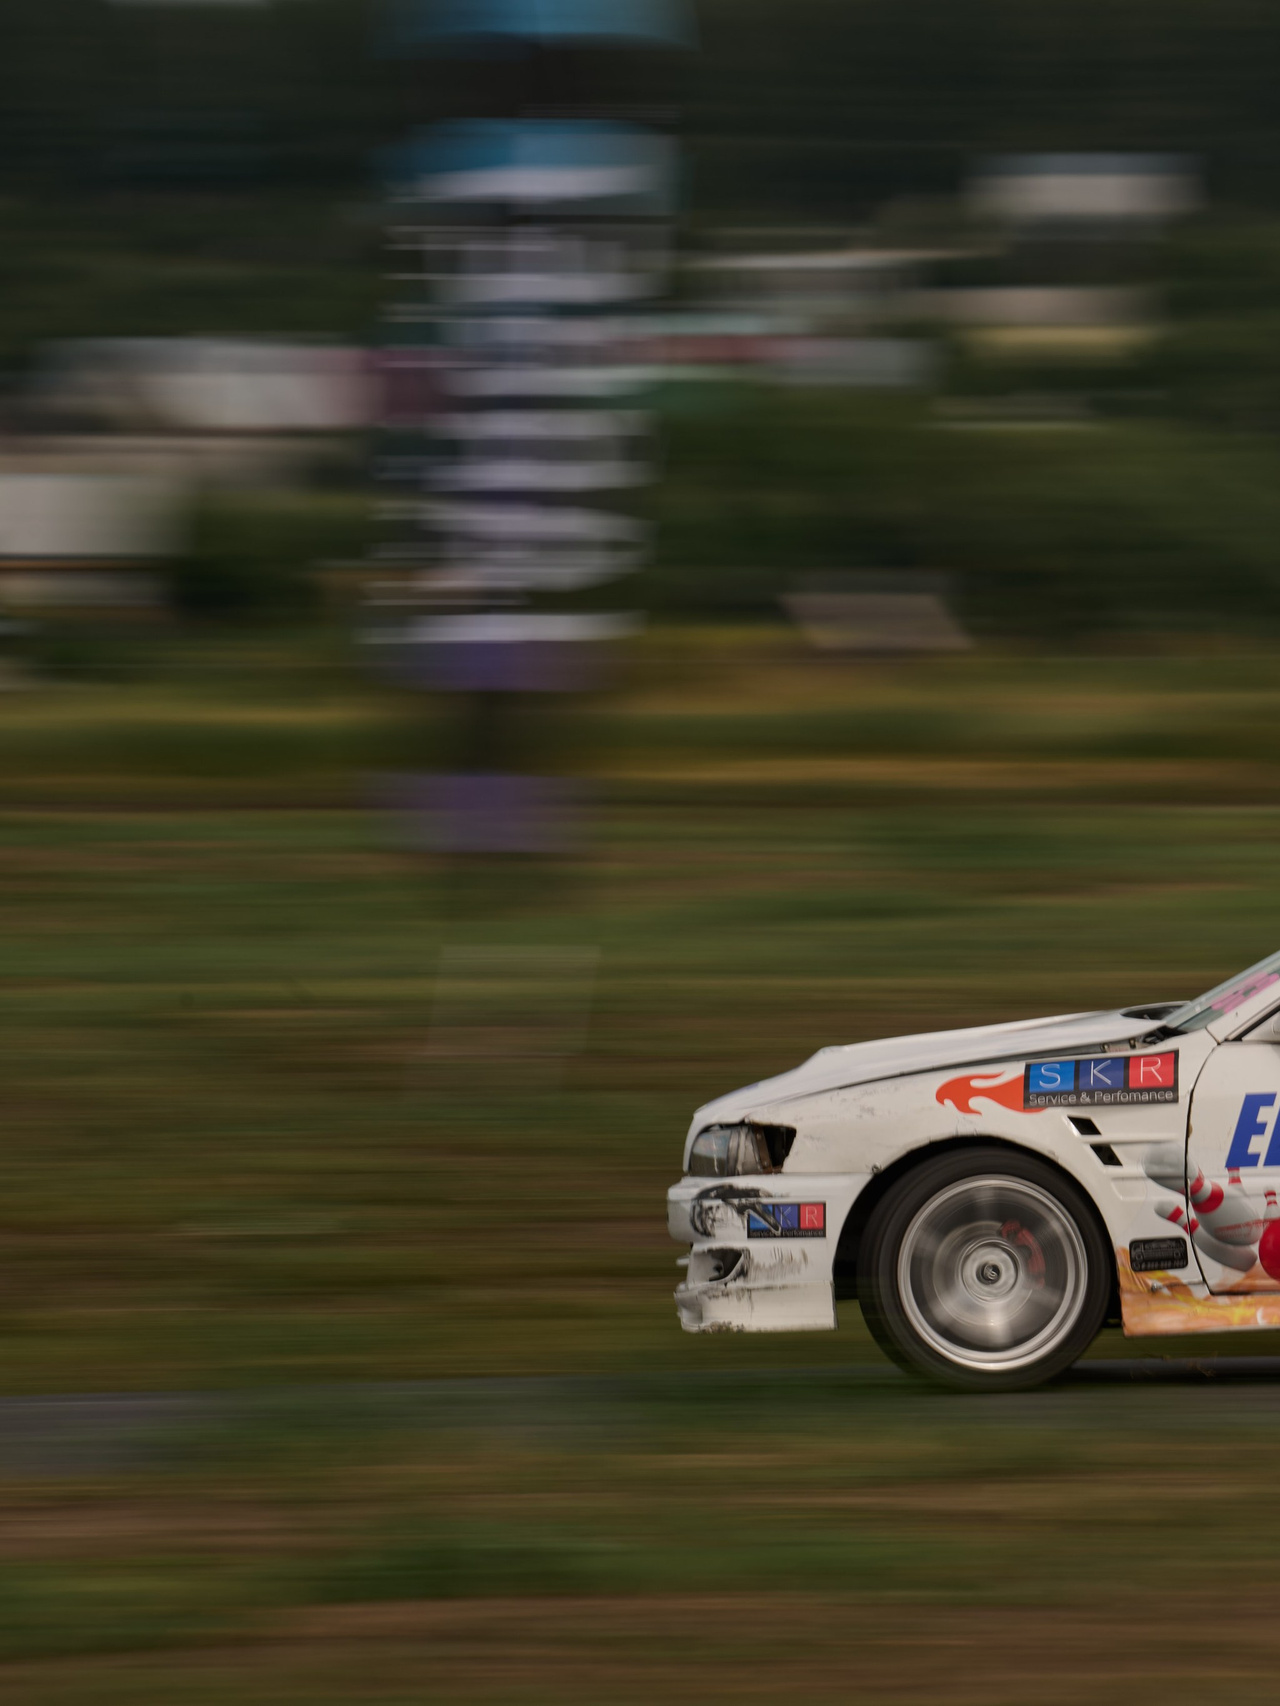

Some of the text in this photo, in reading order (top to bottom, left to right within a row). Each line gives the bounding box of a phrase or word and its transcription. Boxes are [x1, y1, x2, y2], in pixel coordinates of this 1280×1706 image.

[1039, 1056, 1163, 1089] SKR
[1029, 1089, 1174, 1106] Service & Perfomance
